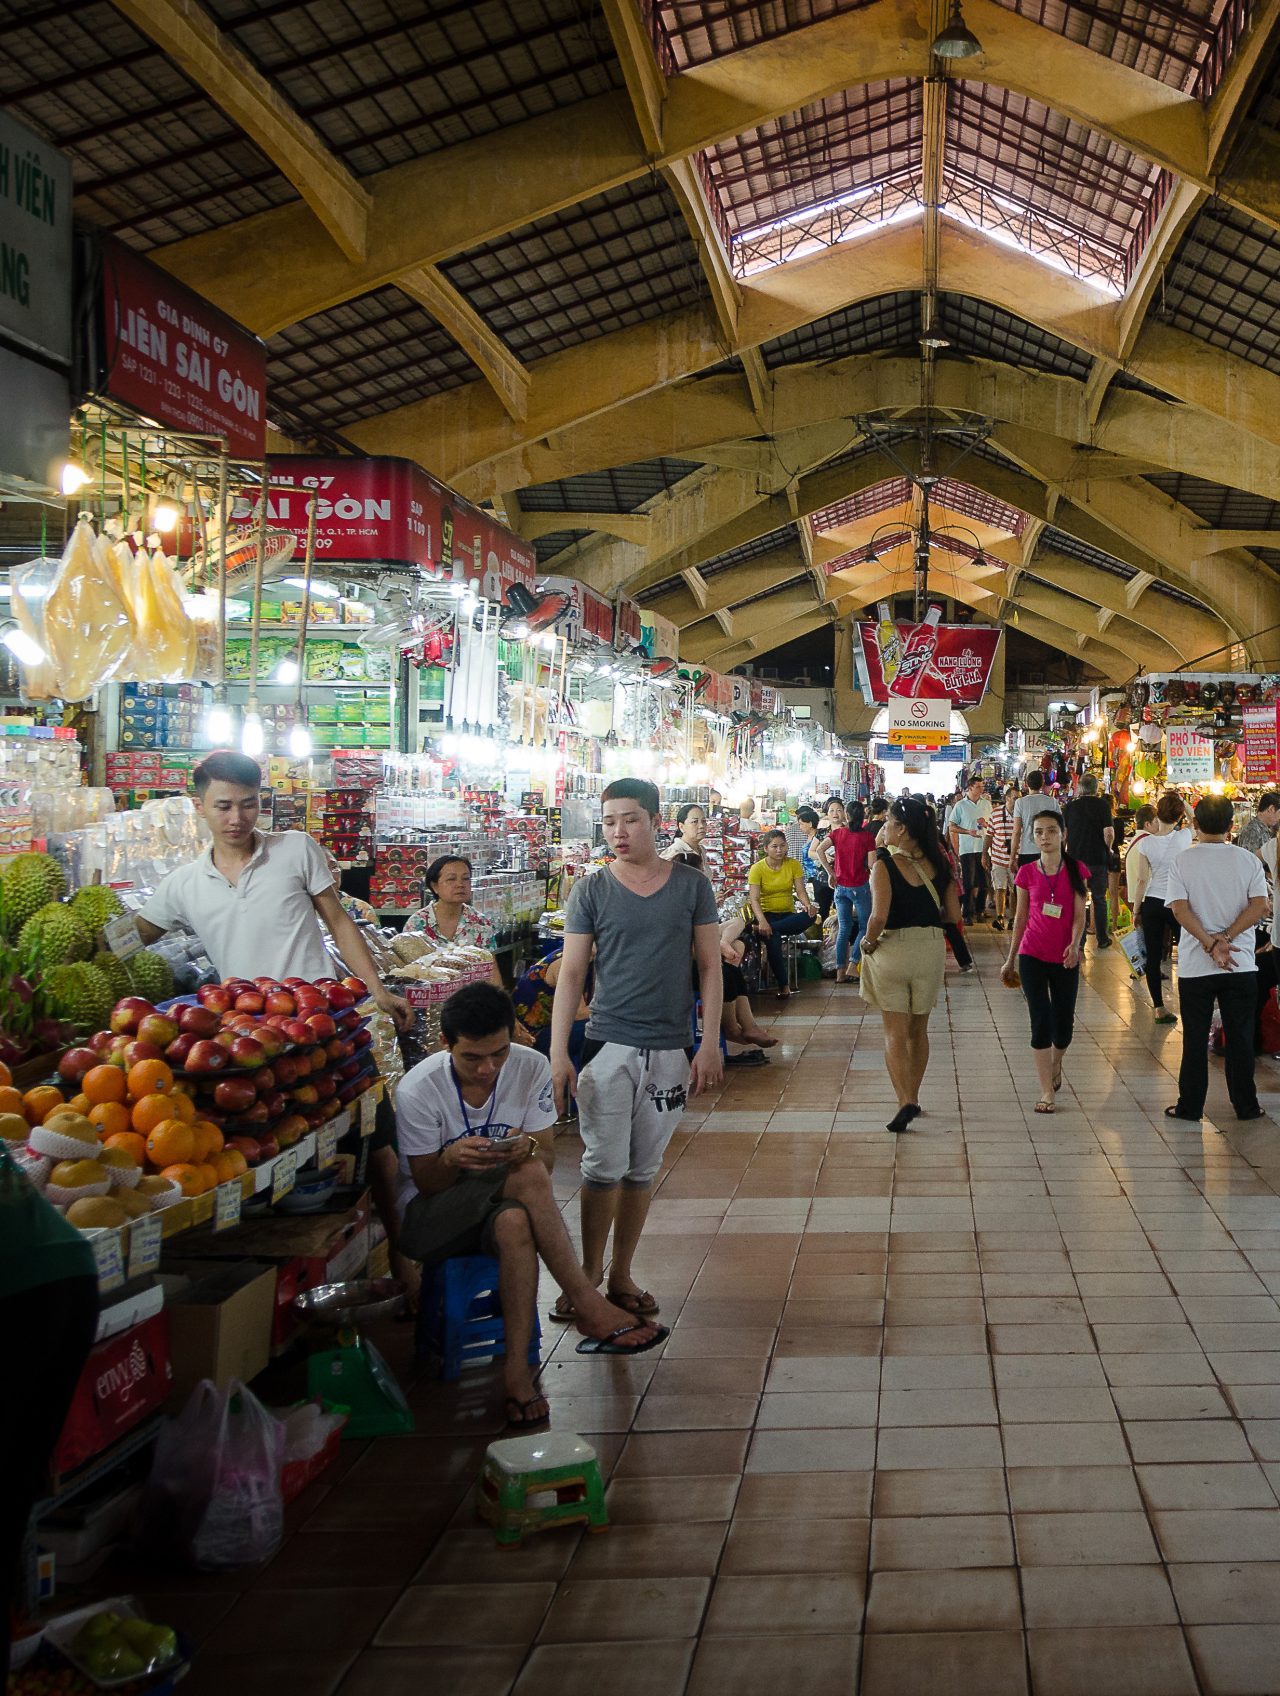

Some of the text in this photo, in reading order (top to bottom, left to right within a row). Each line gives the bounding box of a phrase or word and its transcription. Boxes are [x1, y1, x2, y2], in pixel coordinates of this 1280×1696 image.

[157, 300, 178, 328] GIA
[213, 336, 229, 358] G7
[176, 342, 210, 392] SÀI
[218, 369, 259, 421] GÒN
[303, 477, 335, 489] G7
[305, 493, 391, 520] GÒN
[901, 651, 933, 670] STING
[96, 1359, 133, 1402] envy
